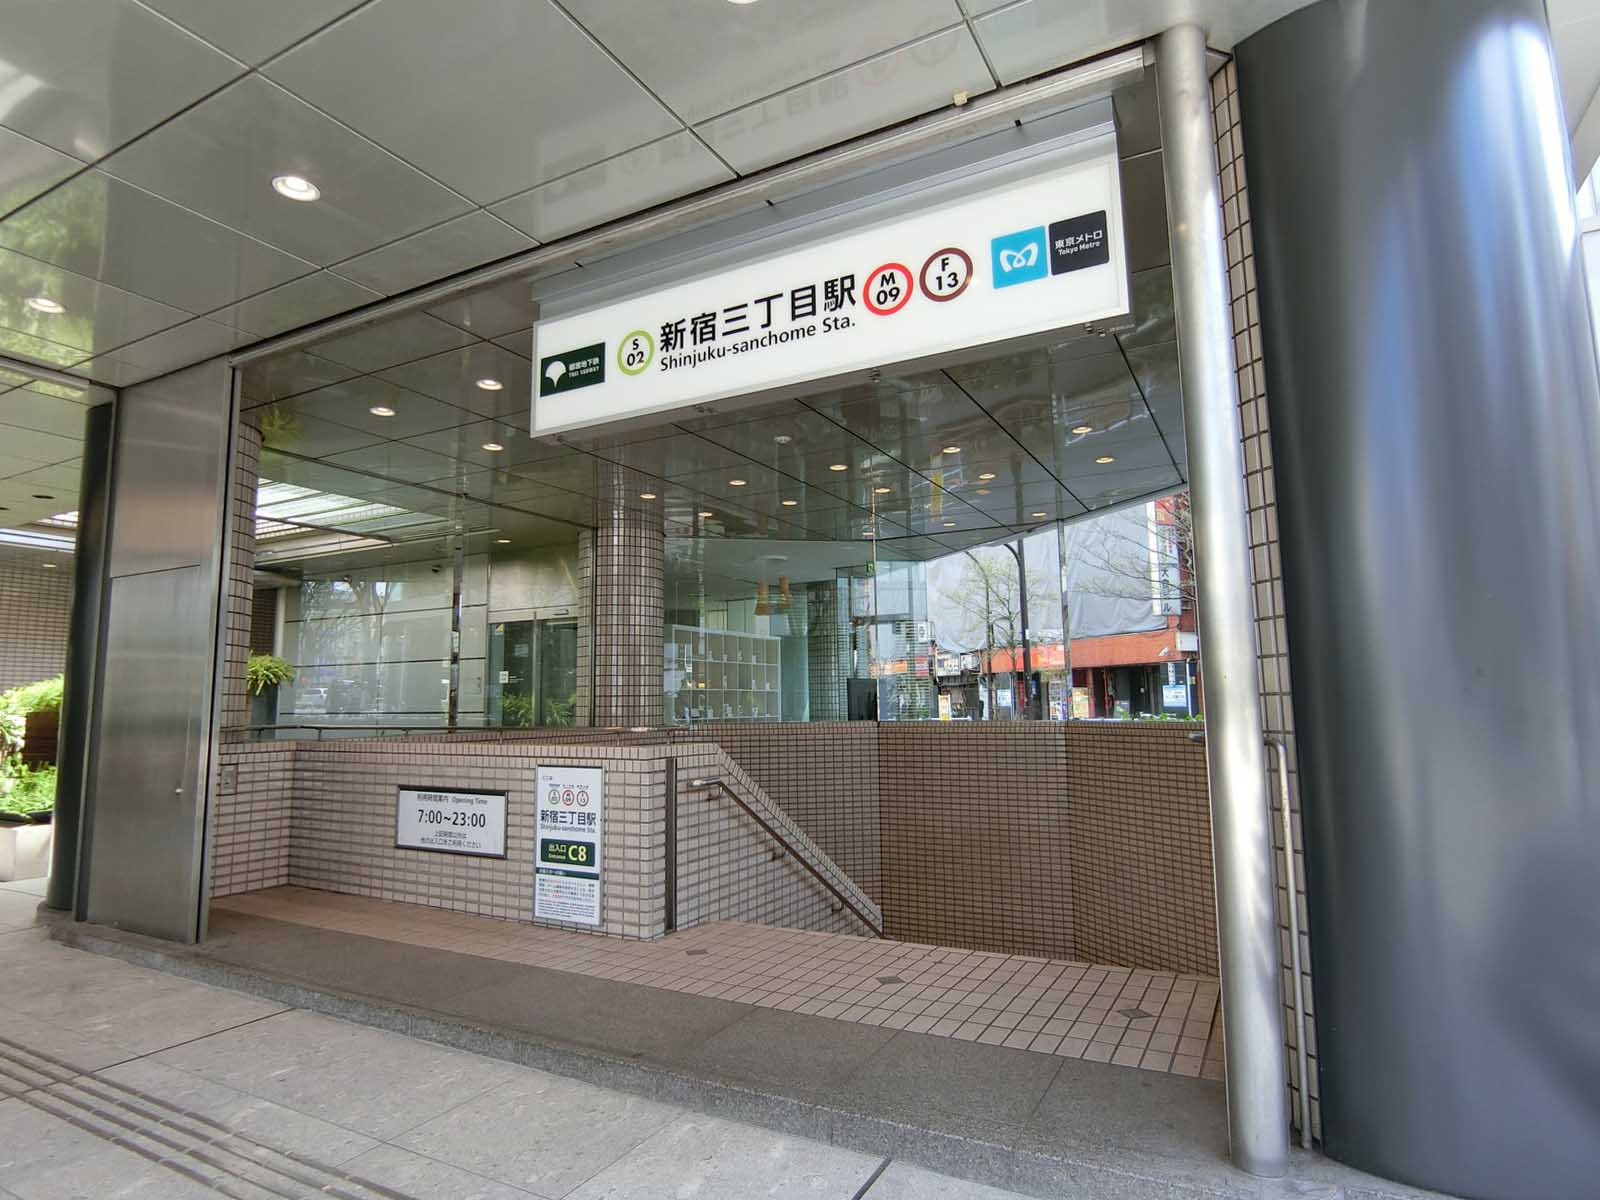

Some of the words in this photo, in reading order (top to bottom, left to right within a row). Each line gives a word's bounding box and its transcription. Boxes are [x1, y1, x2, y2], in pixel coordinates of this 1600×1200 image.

[1055, 230, 1102, 249] 東京メトロ
[1058, 246, 1078, 255] Tokyo
[1079, 241, 1100, 250] Metro
[941, 257, 950, 272] F
[880, 272, 896, 286] M
[935, 273, 959, 290] 13
[876, 287, 900, 305] 09
[659, 273, 856, 353] 新宿三丁目駅
[632, 338, 640, 351] S
[660, 323, 816, 371] Shinjuku-sanchome
[822, 315, 856, 333] Sta.
[627, 351, 645, 367] 02
[452, 796, 473, 805] Opening
[540, 810, 597, 826] 新宿三丁目駅
[548, 844, 566, 853] 出入口
[568, 845, 587, 861] C8
